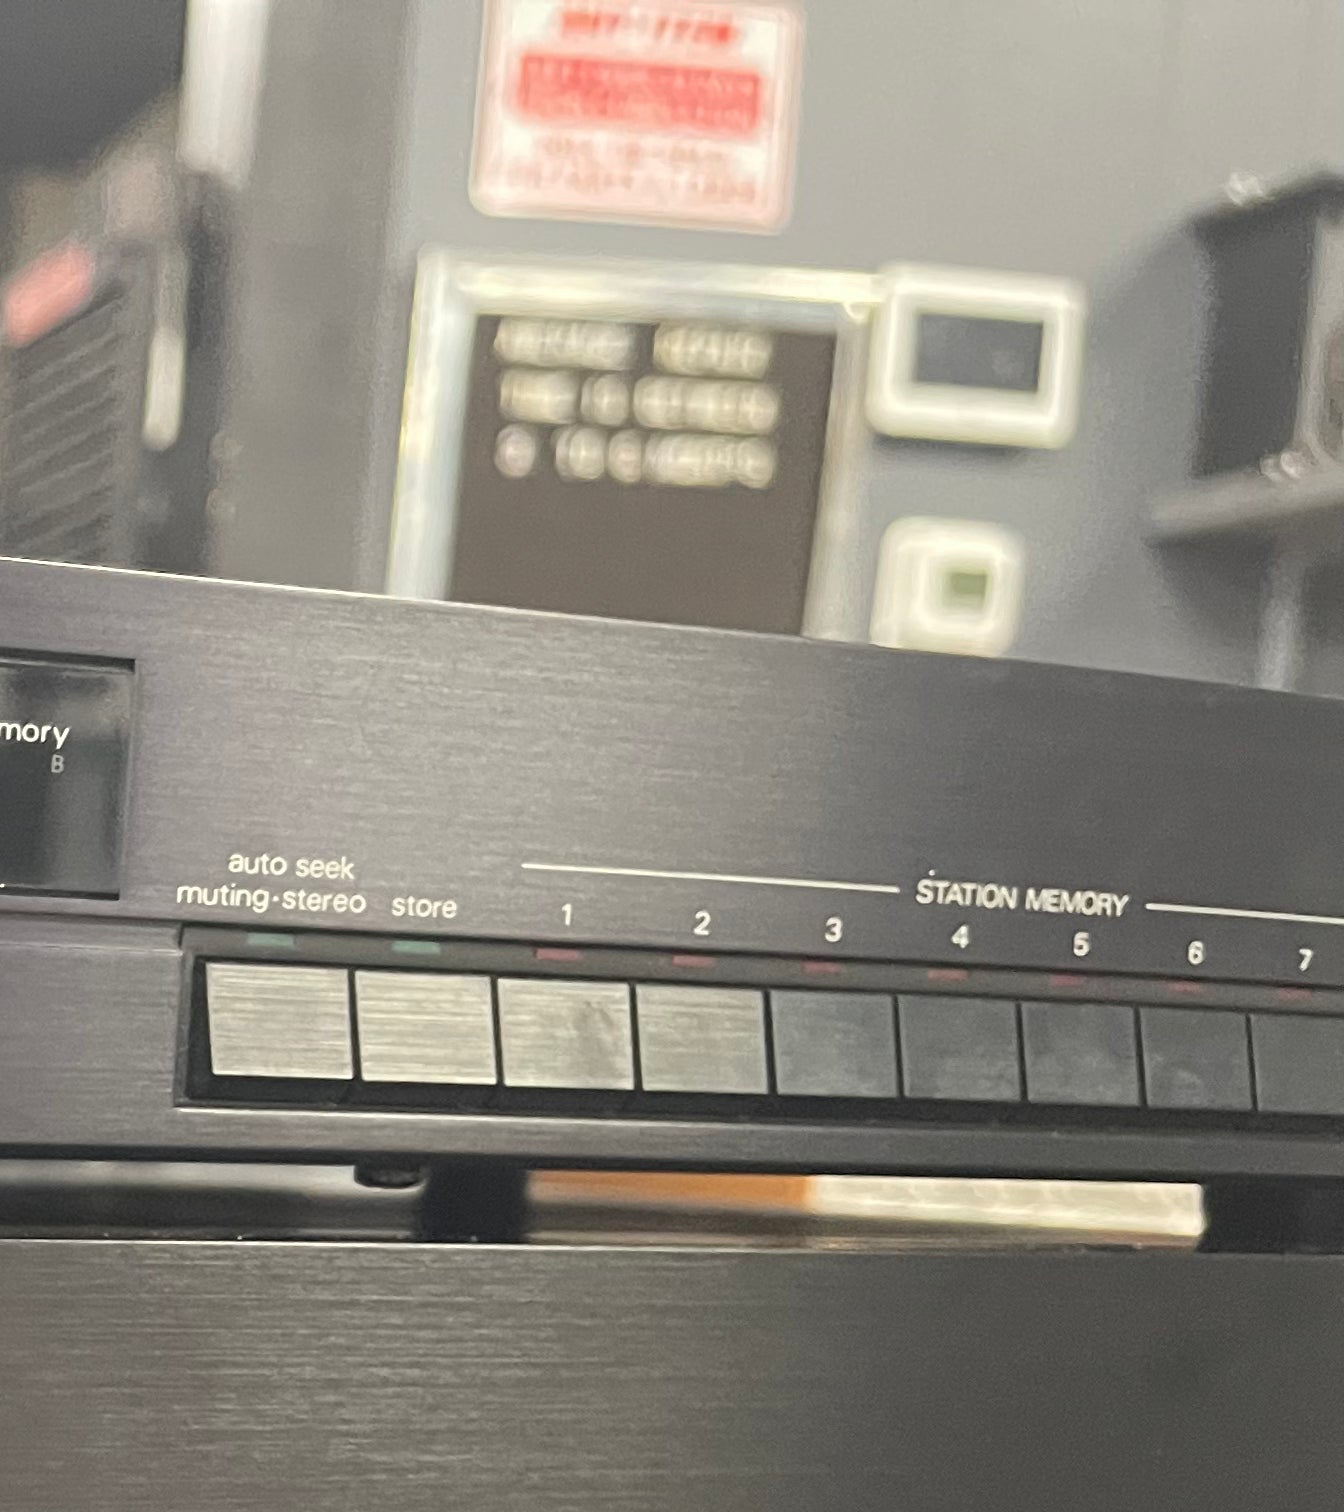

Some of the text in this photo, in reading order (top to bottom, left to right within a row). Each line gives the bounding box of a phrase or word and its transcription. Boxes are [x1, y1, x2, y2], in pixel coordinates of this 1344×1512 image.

[228, 853, 355, 881] auto seek
[392, 896, 457, 920] store
[916, 878, 1129, 918] STATION MEMORY
[561, 904, 574, 927] 1
[693, 911, 712, 937] 2
[825, 917, 843, 943] 3
[951, 924, 970, 950] 4
[1072, 931, 1090, 956] 5
[1187, 940, 1205, 965] 6
[1297, 948, 1314, 973] 7
